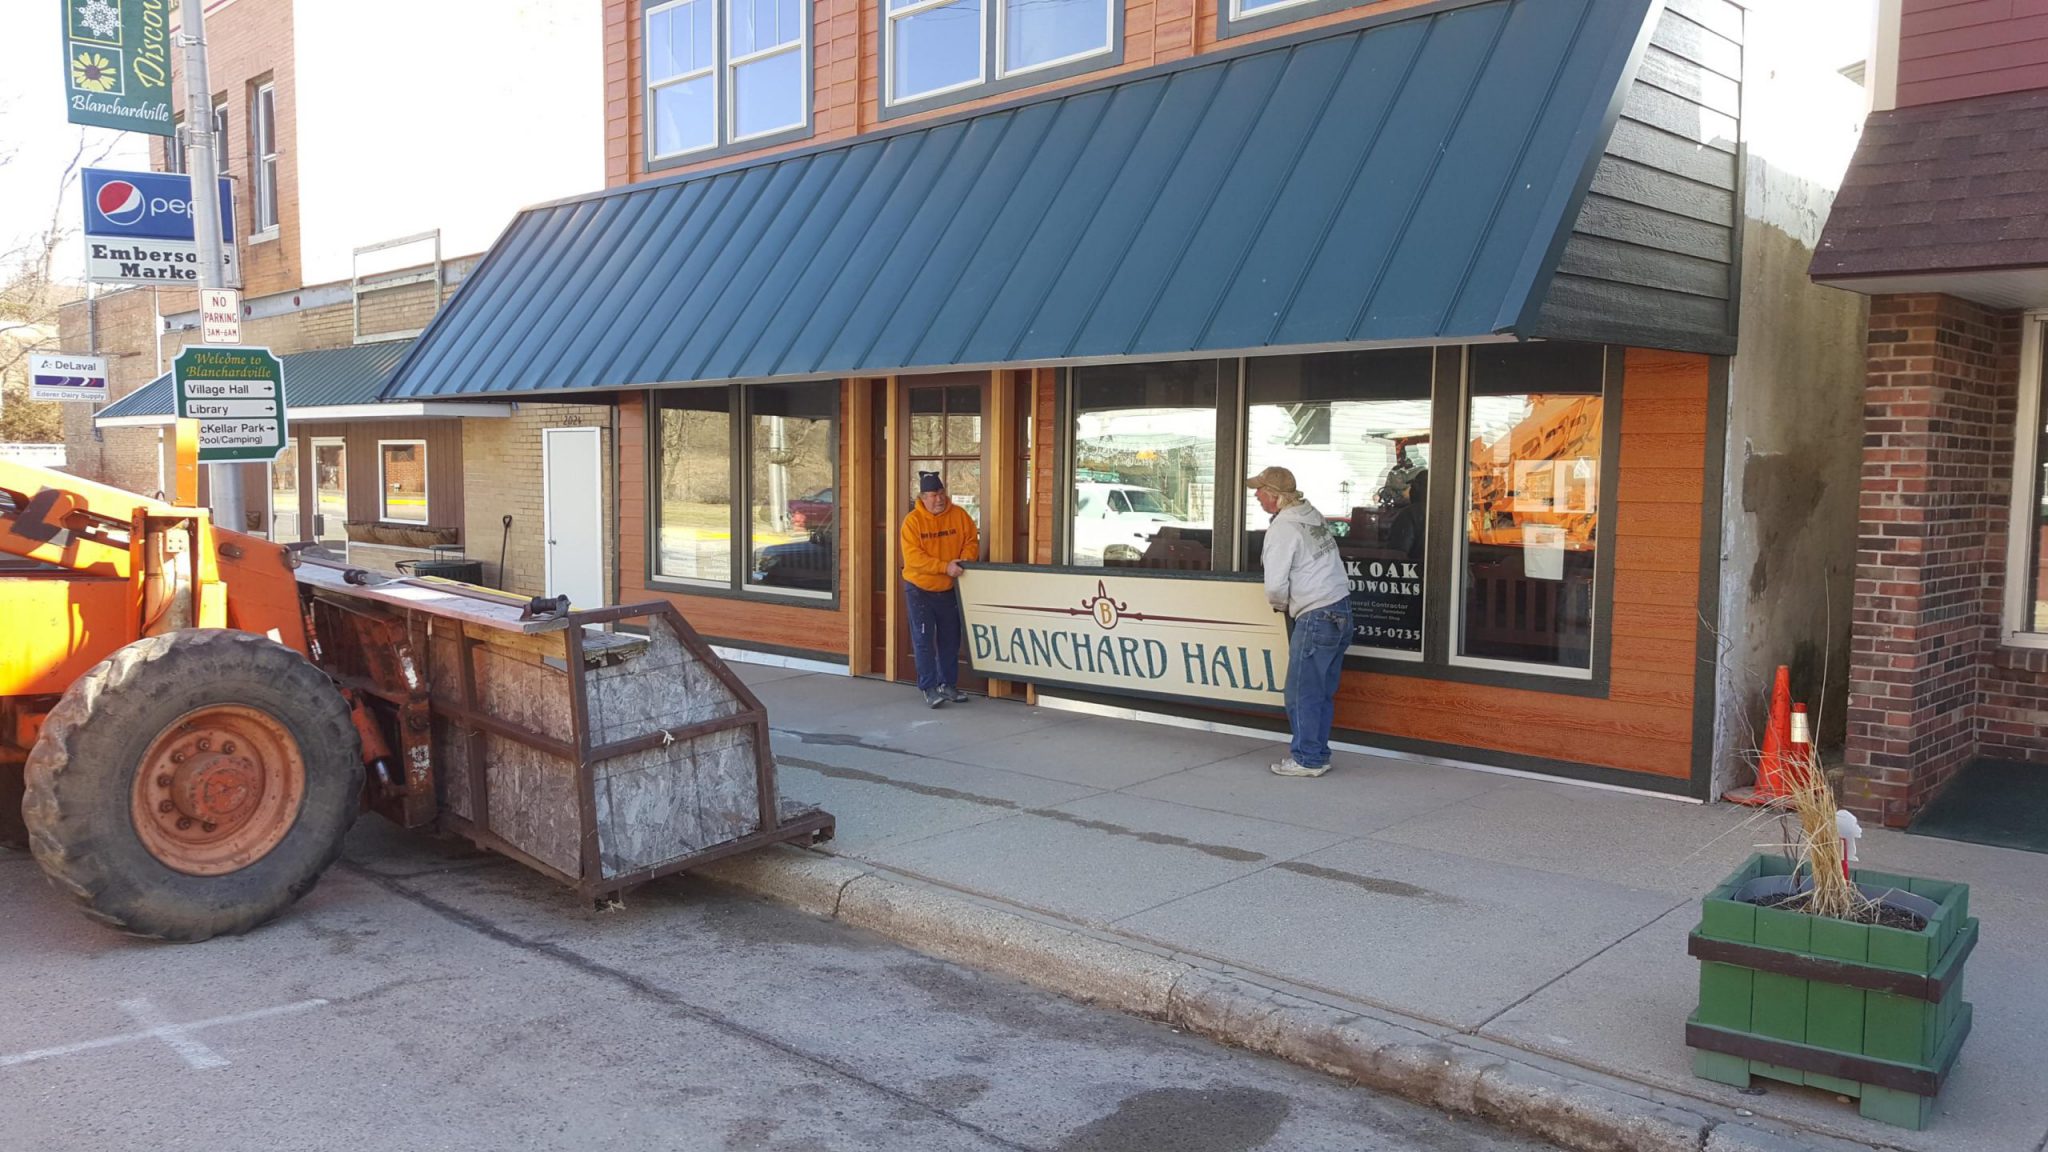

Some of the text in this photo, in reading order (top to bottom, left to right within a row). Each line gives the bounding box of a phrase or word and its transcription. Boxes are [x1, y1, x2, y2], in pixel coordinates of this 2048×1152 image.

[72, 93, 169, 121] Blanchardville
[120, 262, 197, 279] Marke
[212, 296, 227, 307] NO
[204, 312, 237, 323] PARKING
[194, 352, 262, 365] Welcome to
[55, 360, 96, 371] DeLaval
[186, 365, 271, 378] Blanchardville
[188, 384, 249, 396] Village Hall
[188, 404, 229, 416] Library
[200, 423, 265, 433] cKellar Park
[199, 435, 263, 445] Pool/Camping)
[1369, 562, 1419, 579] OAK
[1348, 579, 1420, 596] ODWORKS
[1101, 602, 1113, 625] B
[1353, 624, 1421, 641] -235-0735
[971, 623, 1285, 693] BLANCHARD HALL
